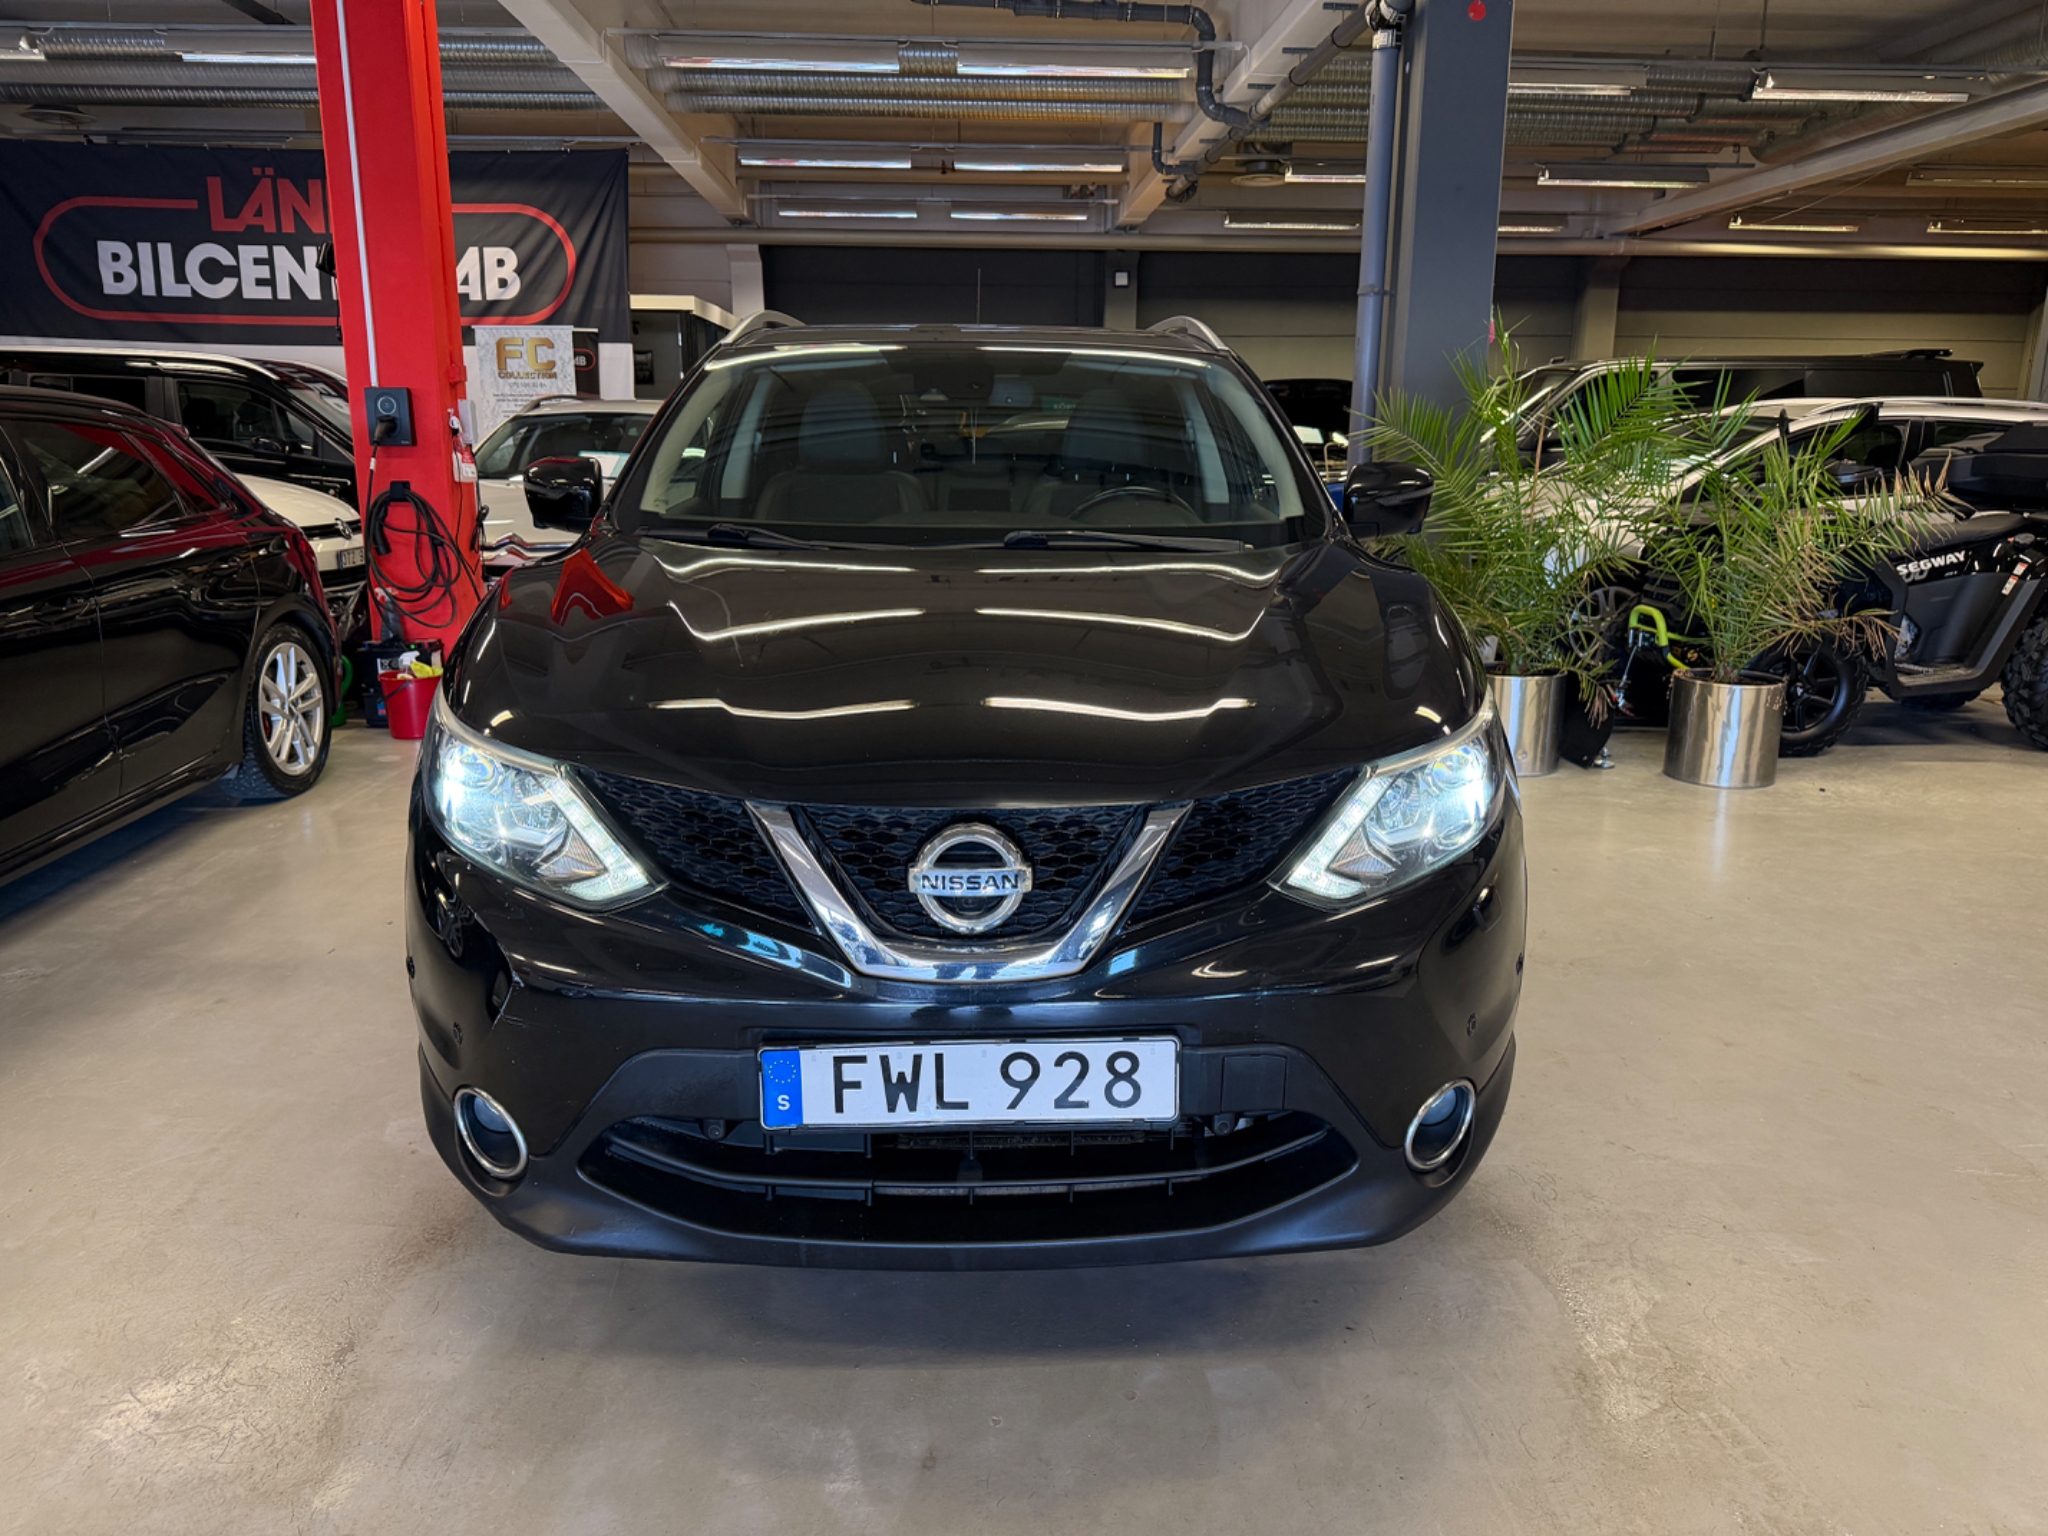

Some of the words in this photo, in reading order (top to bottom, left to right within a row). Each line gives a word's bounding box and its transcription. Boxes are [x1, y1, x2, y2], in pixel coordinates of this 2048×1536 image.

[206, 167, 333, 235] LÄN
[96, 240, 338, 300] BILCEN
[456, 246, 521, 301] AB
[495, 337, 556, 371] FC
[498, 371, 558, 380] COLLECTION
[1896, 550, 1966, 576] SEGWAY
[920, 873, 1020, 892] NISSAN
[777, 1094, 790, 1112] S
[832, 1053, 969, 1114] FWL
[999, 1050, 1142, 1111] 928
